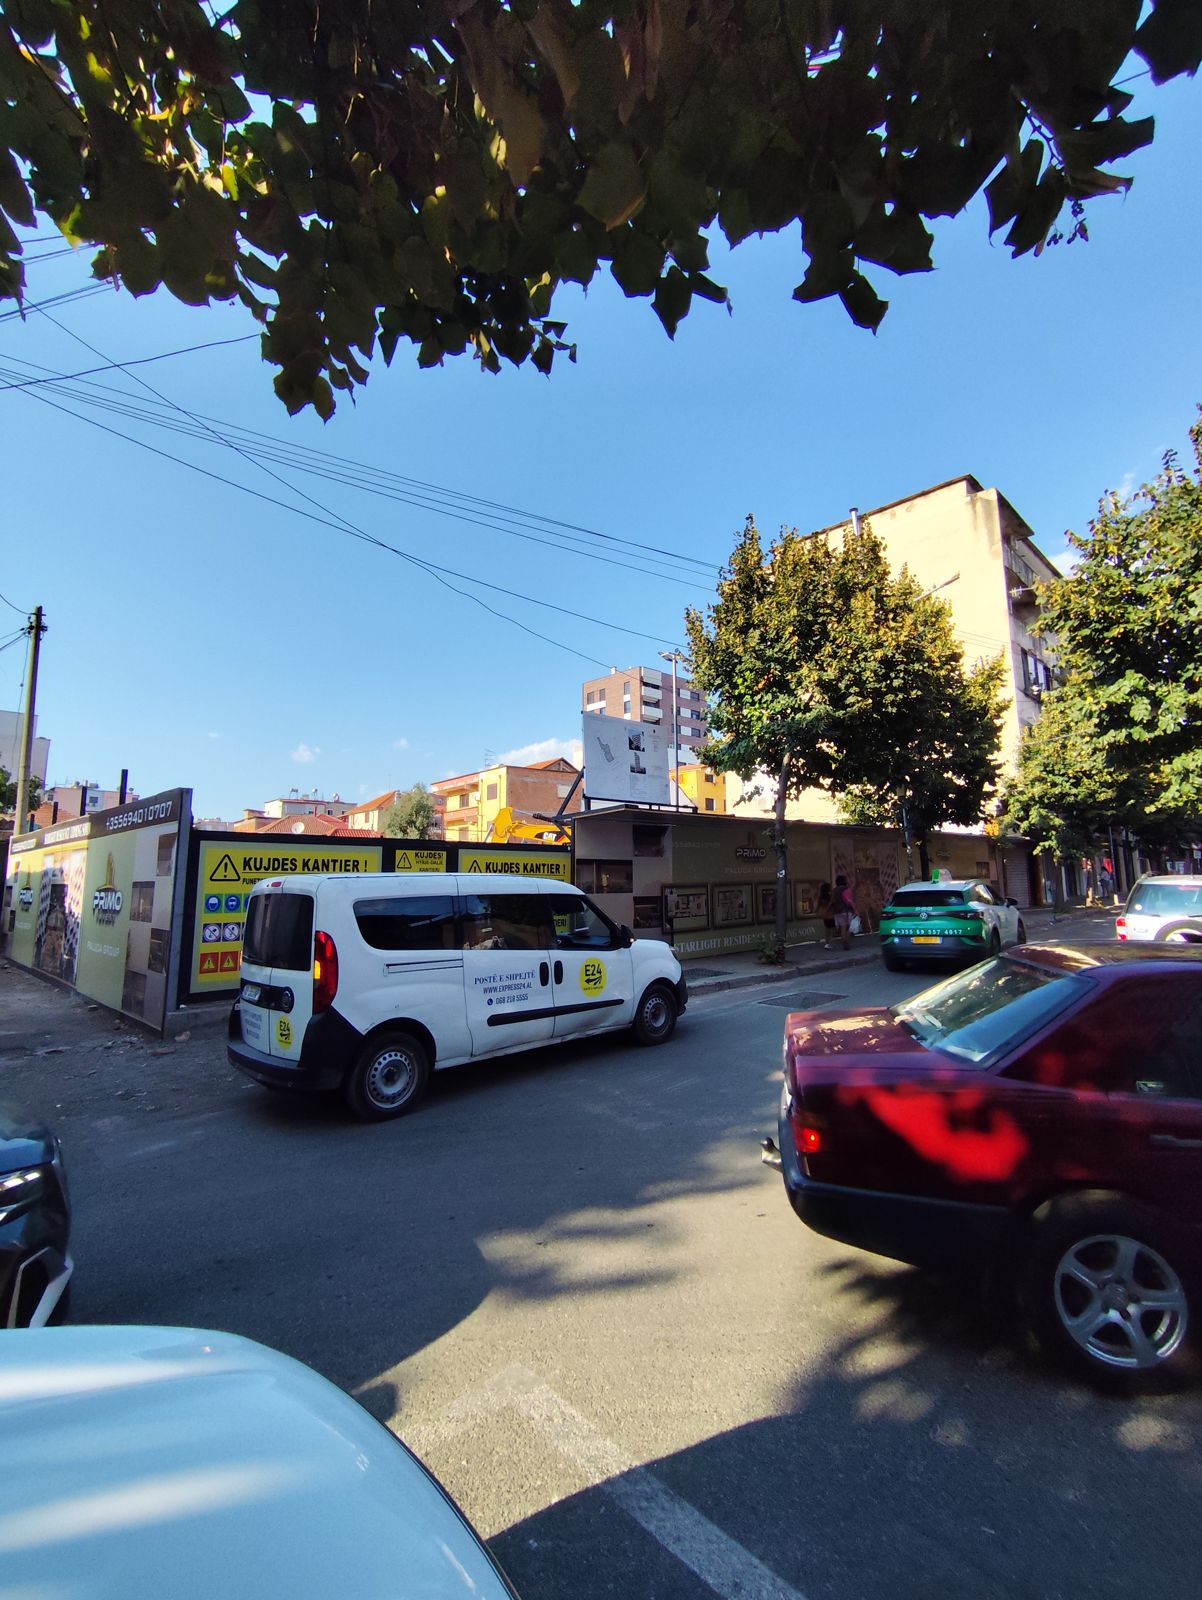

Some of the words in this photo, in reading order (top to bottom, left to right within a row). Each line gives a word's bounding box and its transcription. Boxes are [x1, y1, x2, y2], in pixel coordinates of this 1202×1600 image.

[106, 801, 172, 830] +355694010707
[543, 832, 557, 841] CAT
[243, 857, 297, 871] KUJDES
[302, 859, 360, 872] KANTIER
[485, 862, 520, 873] KUJDES
[523, 863, 560, 874] KANTIER
[585, 964, 602, 976] E24
